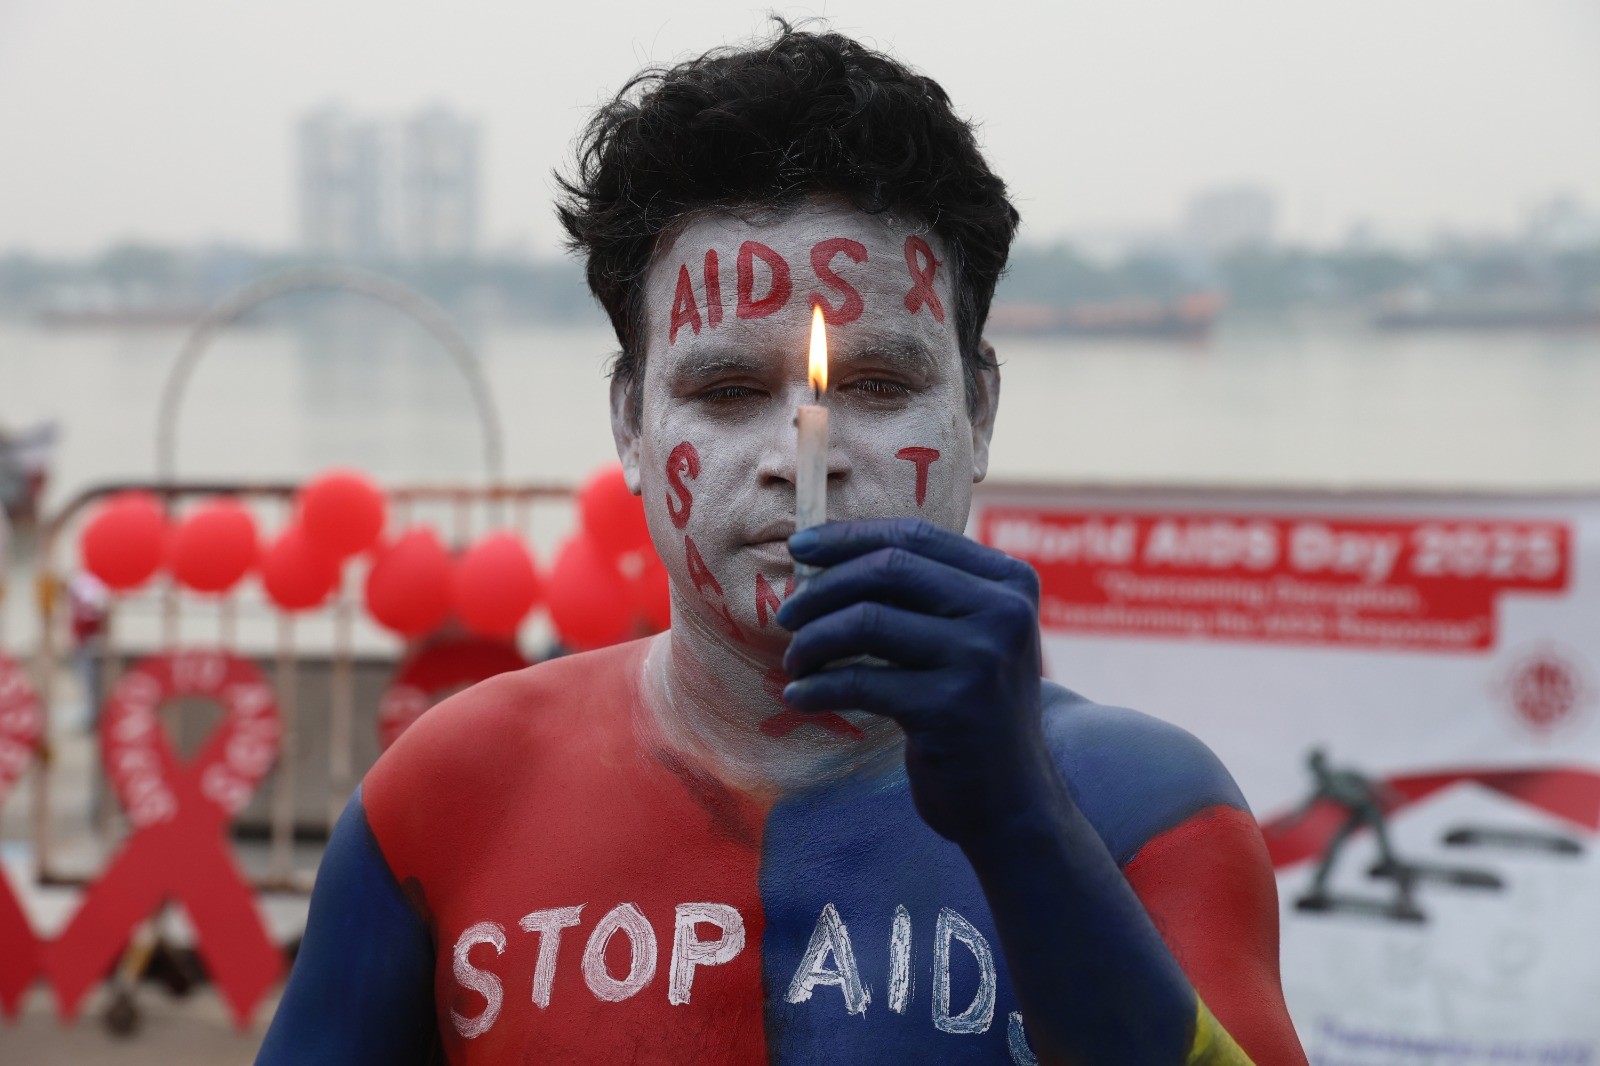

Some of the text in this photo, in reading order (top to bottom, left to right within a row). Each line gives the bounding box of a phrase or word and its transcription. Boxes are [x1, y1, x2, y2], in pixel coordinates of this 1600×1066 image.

[669, 238, 868, 344] AIDS
[991, 520, 1560, 586] World AIDS Day 2025
[450, 901, 1039, 1066] STOP AID
